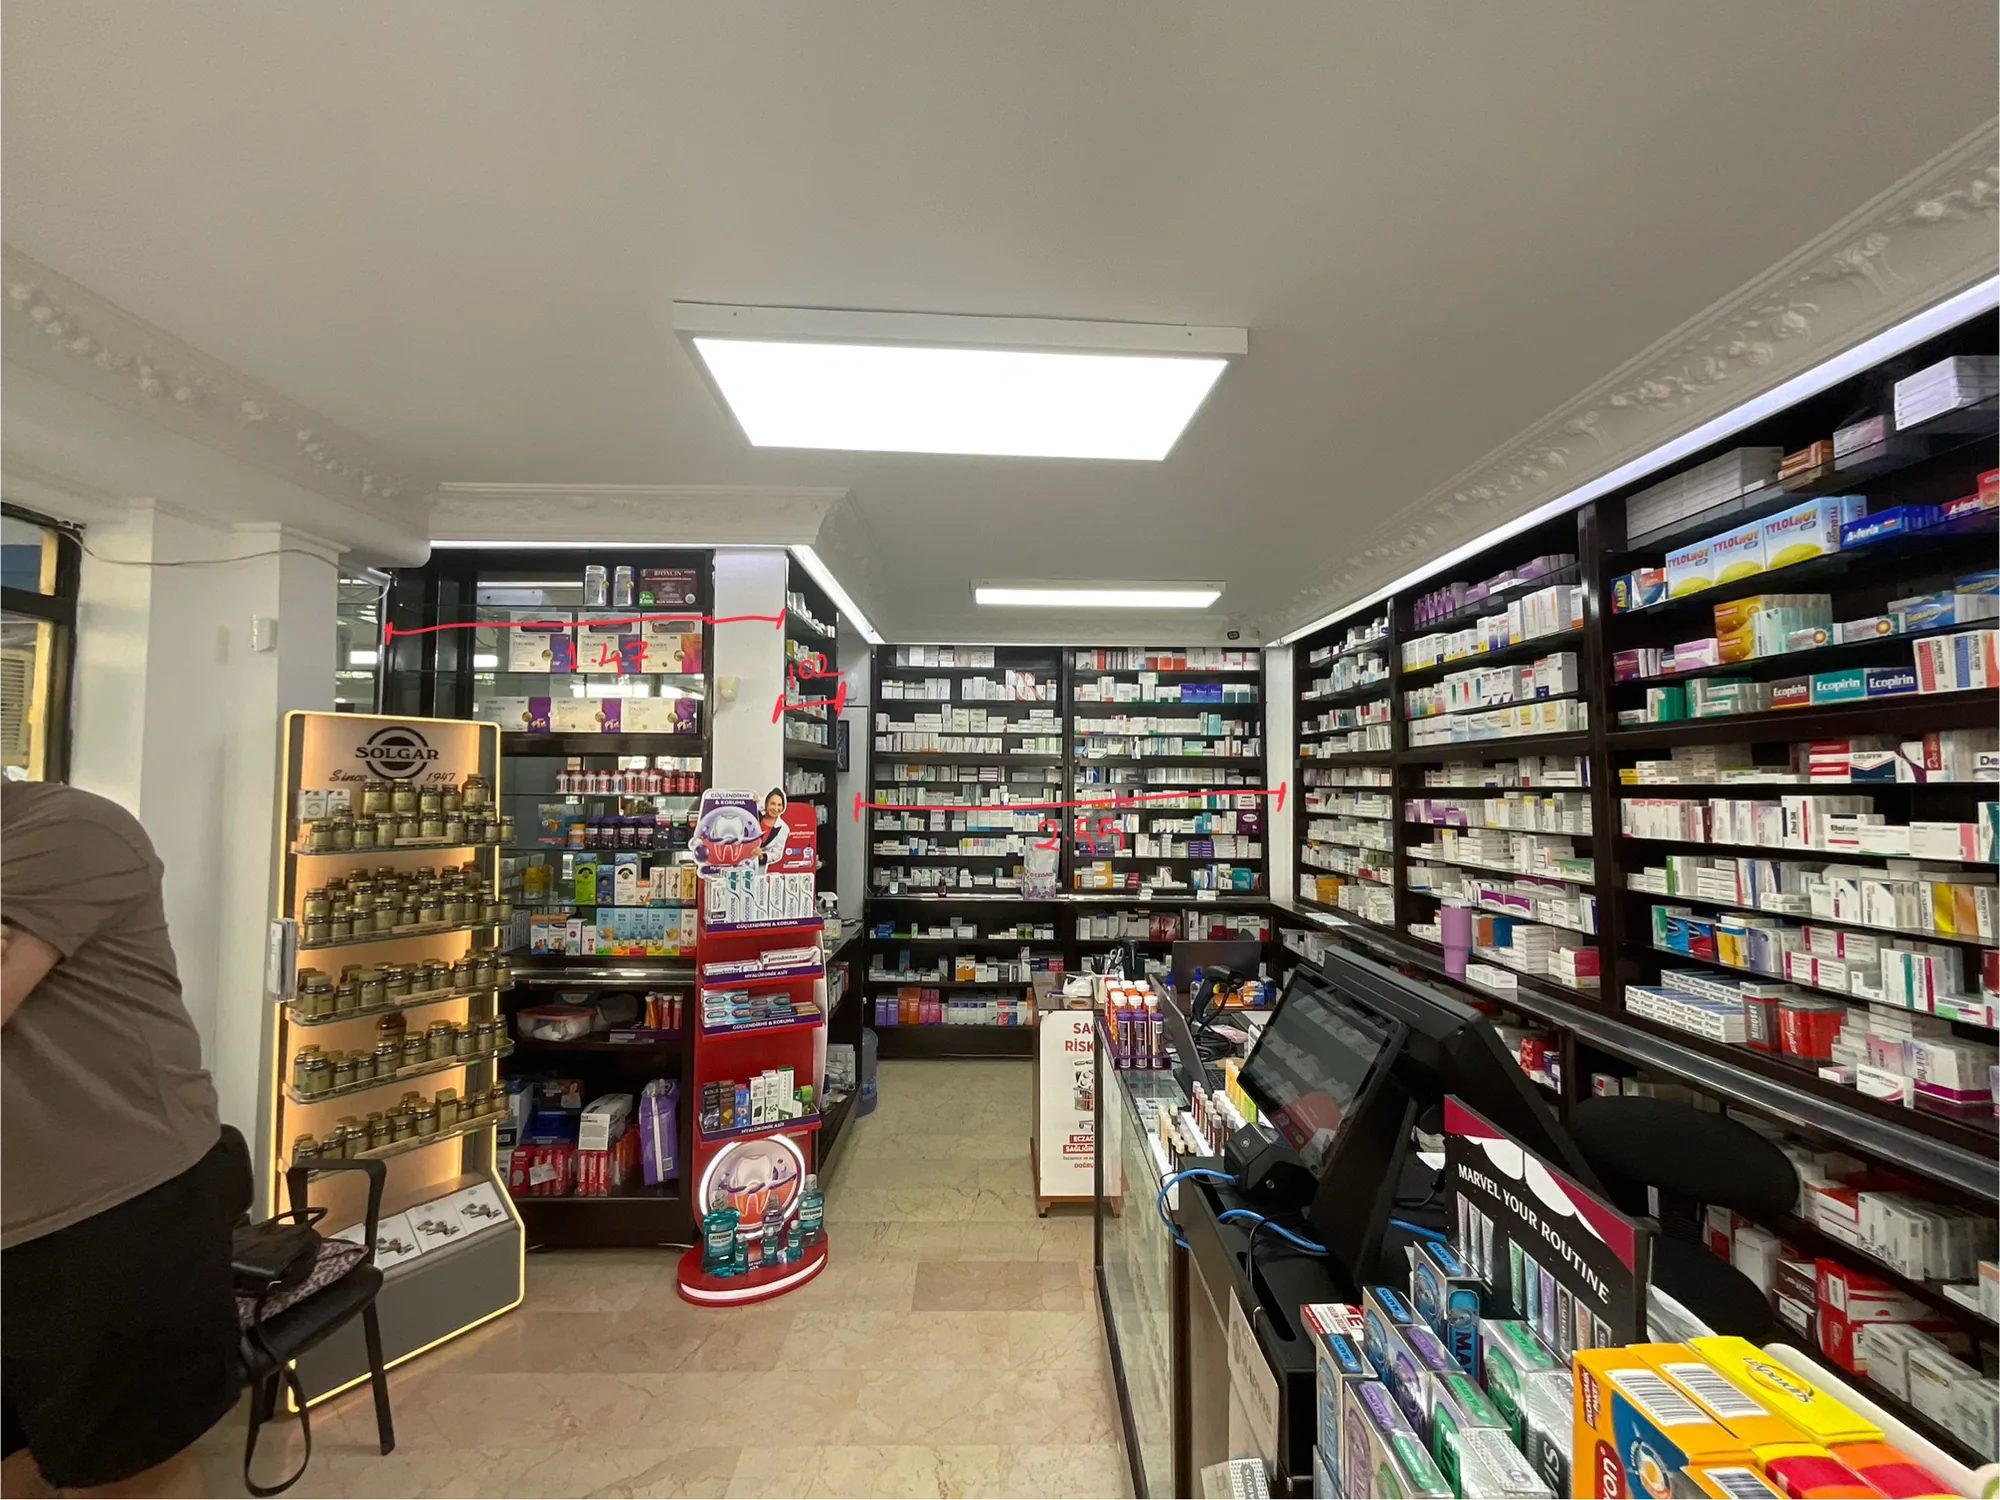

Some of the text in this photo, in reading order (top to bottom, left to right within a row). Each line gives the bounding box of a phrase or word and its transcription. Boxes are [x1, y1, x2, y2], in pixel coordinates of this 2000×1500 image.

[1816, 678, 1860, 692] Ecopirin
[1869, 674, 1914, 690] Ecopirin
[1774, 684, 1806, 697] Ecopirin
[355, 746, 439, 760] SOLGAR
[329, 769, 456, 782] Since 1947
[768, 954, 798, 962] parodontax
[1458, 1163, 1610, 1304] MARVEL YOUR ROUTINE
[1242, 1349, 1272, 1426] MARVIS
[1582, 1369, 1594, 1427] EKONOMİK
